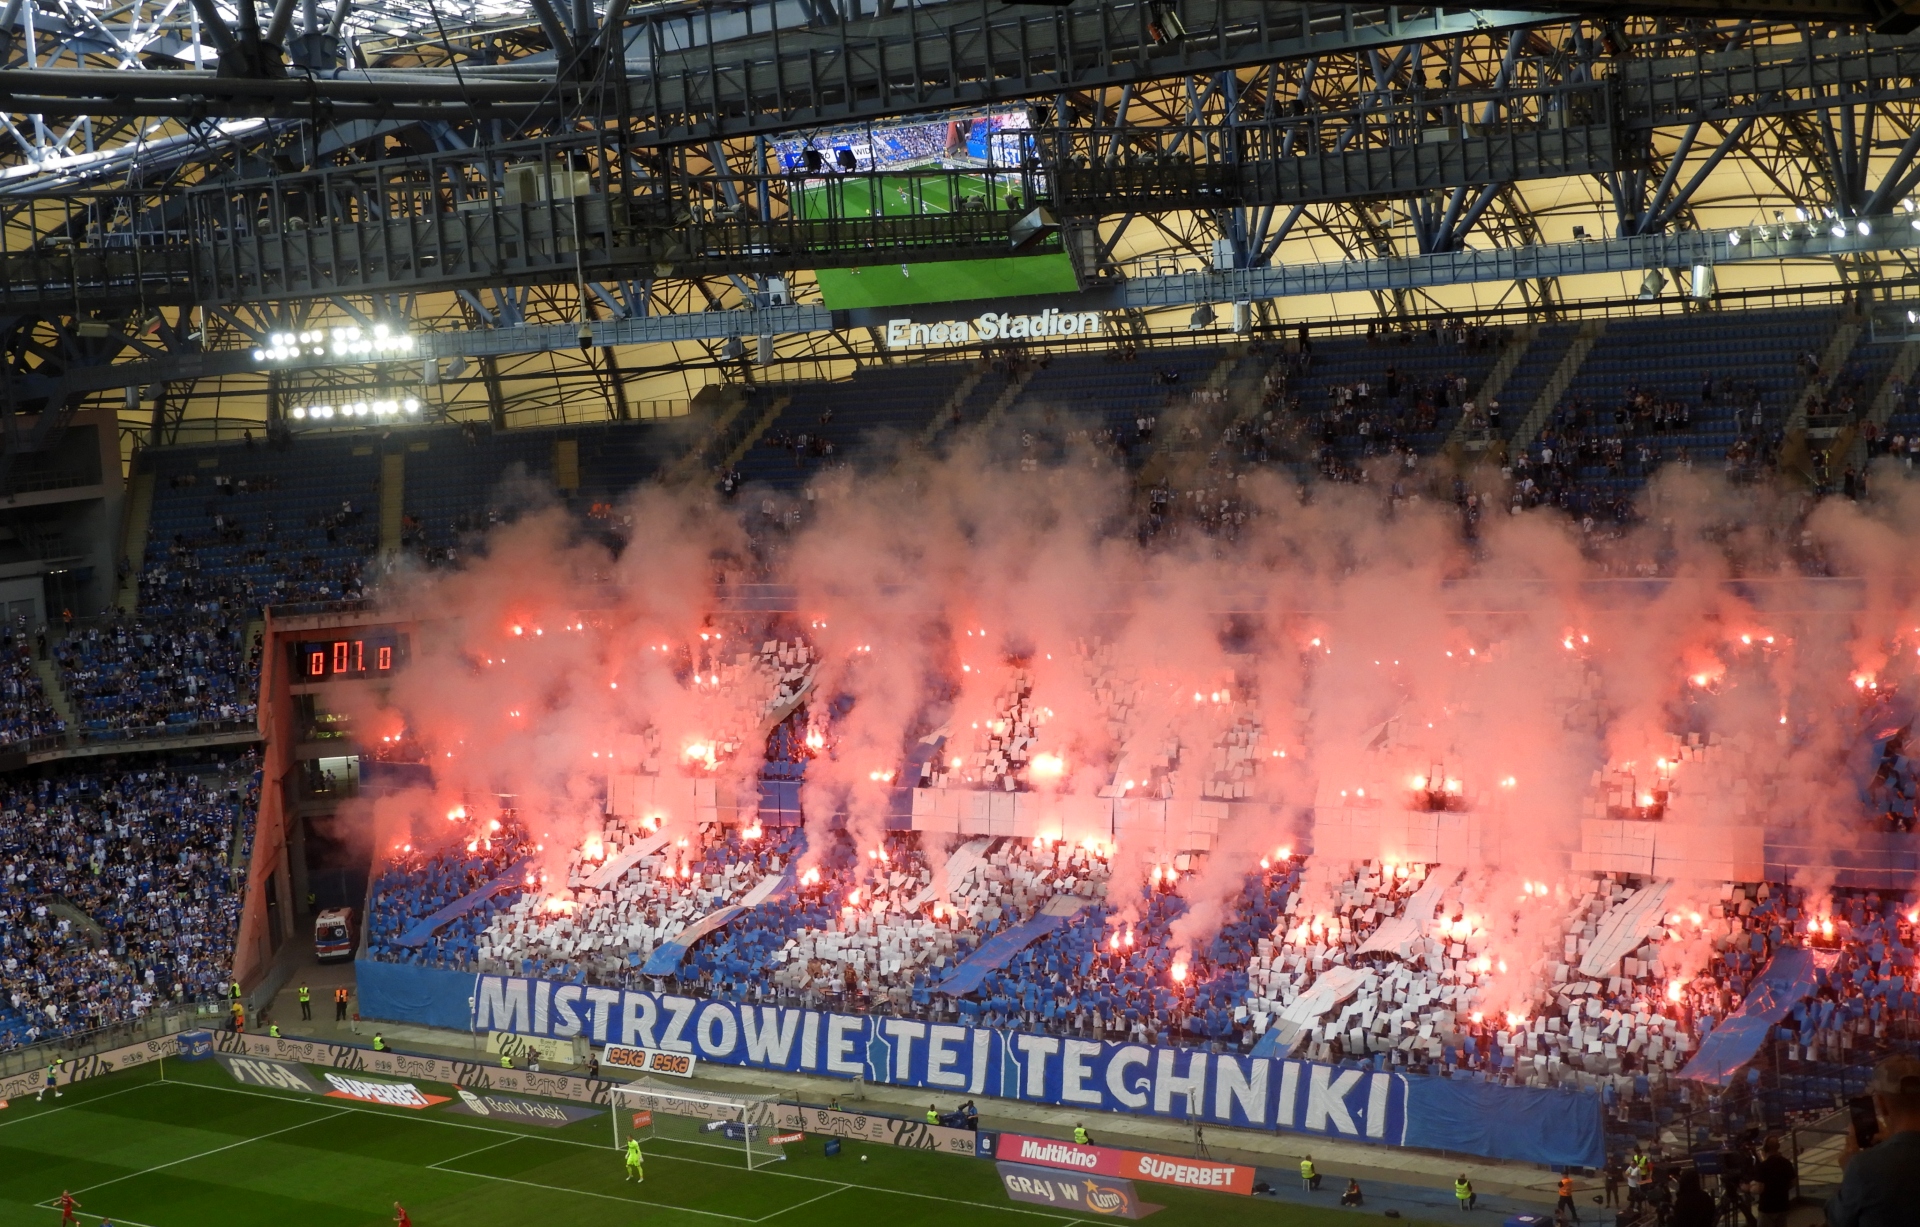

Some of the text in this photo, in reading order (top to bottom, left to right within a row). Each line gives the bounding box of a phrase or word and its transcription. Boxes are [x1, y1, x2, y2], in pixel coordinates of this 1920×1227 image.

[887, 308, 1100, 347] Enea Stadion
[312, 652, 324, 675] 0
[379, 647, 391, 669] 0
[214, 1029, 251, 1056] Pils
[496, 1032, 528, 1059] Pils
[60, 1054, 114, 1083] Pils
[328, 1044, 369, 1072] Pils
[476, 975, 1391, 1139] MISTRZOWIE TEJ TECHNIKI
[609, 1047, 646, 1067] eska
[653, 1053, 690, 1074] eska
[324, 1072, 429, 1105] SUPERBET
[451, 1061, 496, 1089] Pils
[485, 1096, 527, 1116] Bank
[522, 1102, 569, 1121] Polski
[772, 1133, 802, 1144] SUPERBET
[887, 1118, 942, 1151] Pils
[1020, 1140, 1097, 1168] Multikino
[1138, 1156, 1235, 1186] SUPERBET
[1005, 1174, 1121, 1208] GRAJ W LOTTO
